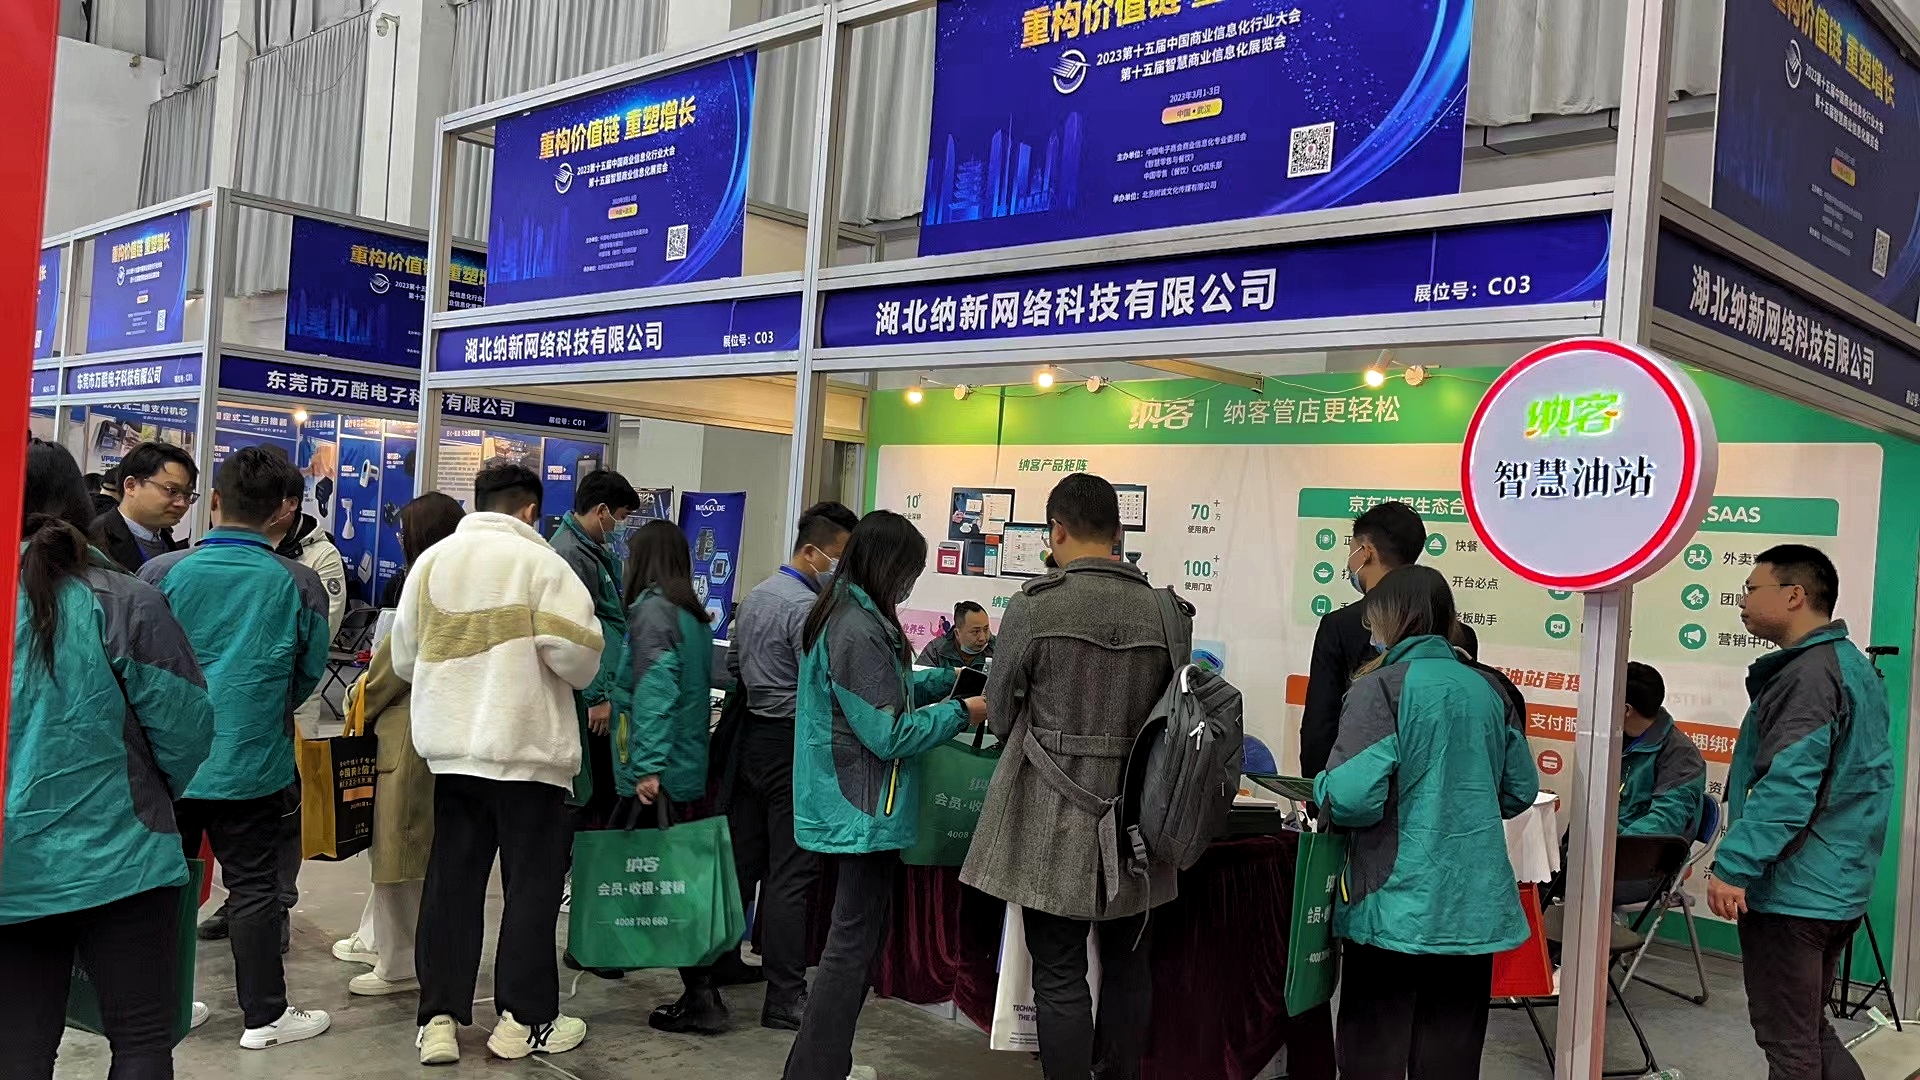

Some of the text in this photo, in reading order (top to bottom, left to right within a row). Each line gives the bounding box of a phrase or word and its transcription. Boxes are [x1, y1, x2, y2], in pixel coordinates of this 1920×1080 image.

[1096, 8, 1302, 66] 2023第十五届中国商业信息化行业大会
[1120, 34, 1286, 82] 第十五届智慧商业信息化展览会
[539, 95, 696, 160] 重构价值链 重塑增长
[875, 267, 1277, 336] 湖北纳新网络科技有限公司
[464, 321, 663, 363] 湖北纳新网络科技有限公司
[1689, 264, 1875, 385] 湖北纳新网络科技有限公司
[76, 365, 163, 390] 东莞市万酷电子科技有限公司
[266, 370, 516, 417] 东莞市万酷电子科有限公司
[1223, 395, 1401, 425] 纳客管店更轻松
[1018, 458, 1088, 472] 纳客产品矩阵
[1494, 455, 1656, 499] 智慧油站
[1455, 540, 1478, 552] 快餐
[1452, 576, 1499, 590] 开台必点
[1718, 632, 1778, 649] 营销中心
[1495, 666, 1581, 692] 油站管理
